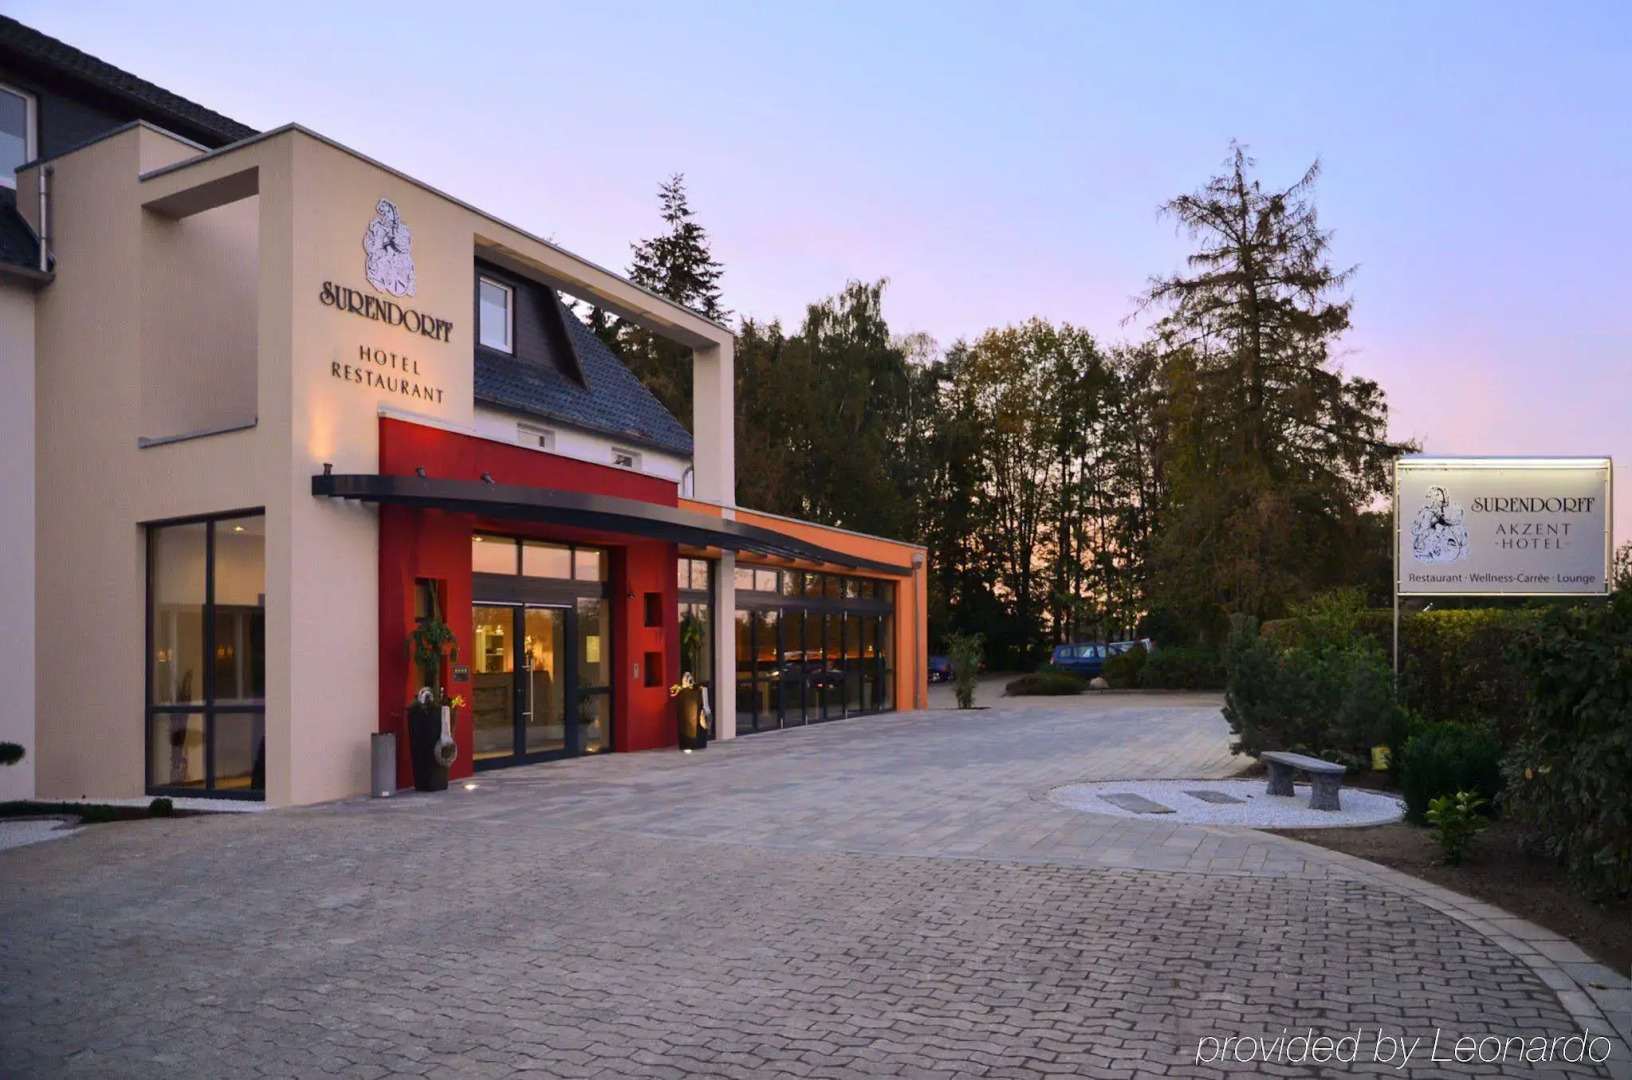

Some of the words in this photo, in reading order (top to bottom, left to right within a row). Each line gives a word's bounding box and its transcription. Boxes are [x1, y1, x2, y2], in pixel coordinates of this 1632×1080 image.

[319, 280, 453, 342] SURENDORFF
[359, 345, 420, 375] HOTEL
[332, 361, 444, 404] RESTAURANT
[1471, 497, 1595, 513] SURENDORFF
[1496, 523, 1572, 535] AKZENT
[1409, 573, 1462, 583] Restaurant
[1557, 574, 1596, 586] Lounge
